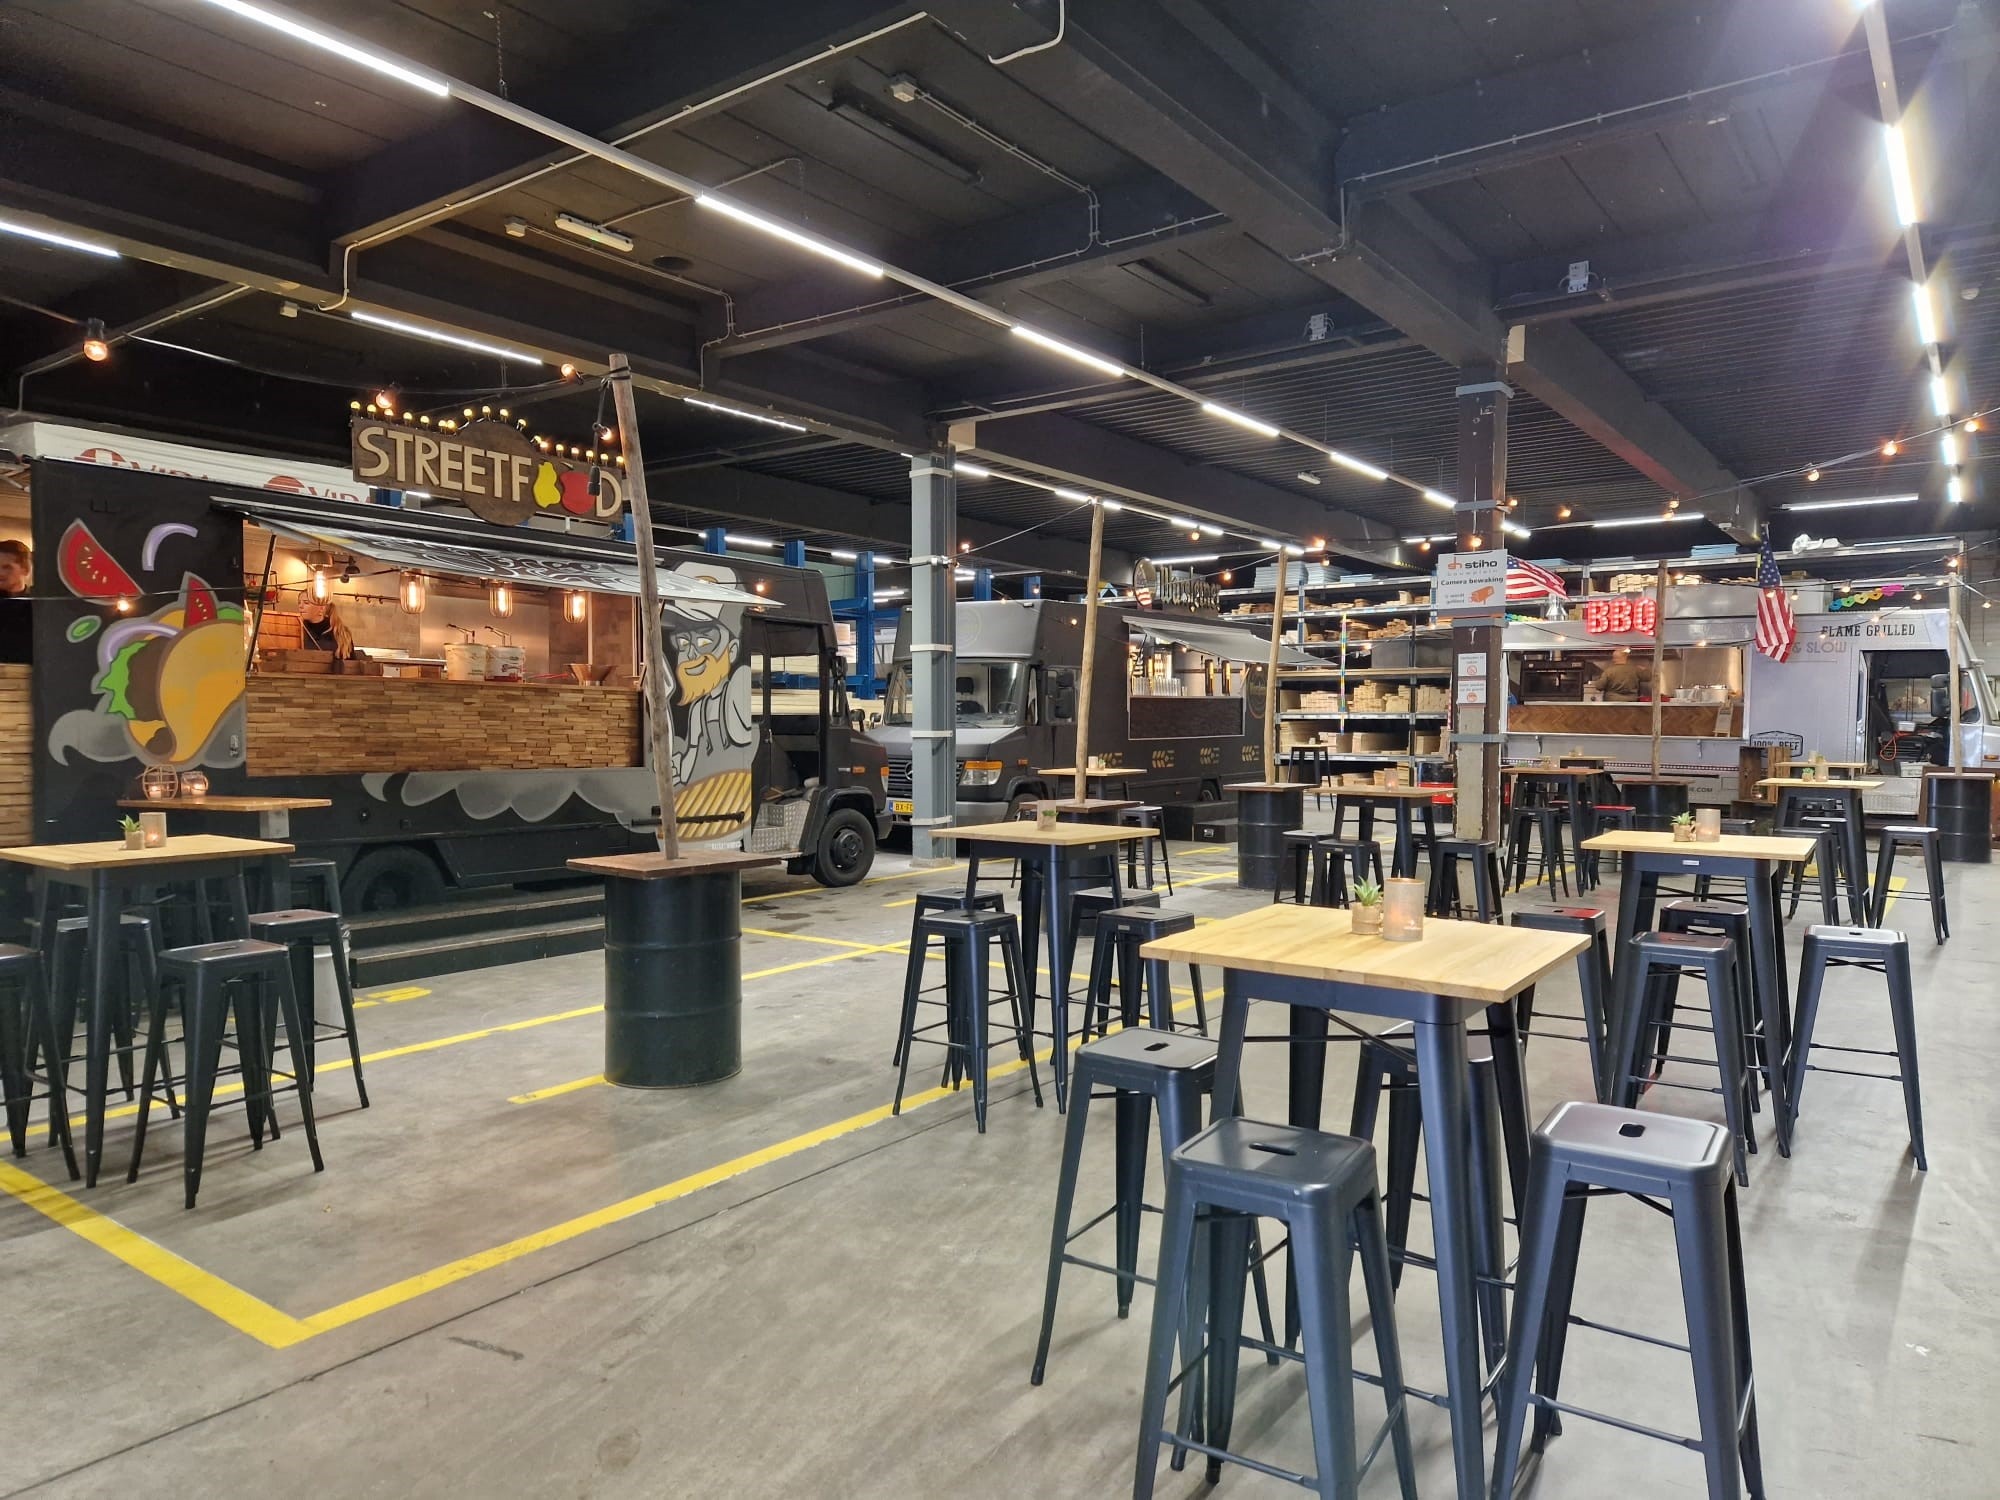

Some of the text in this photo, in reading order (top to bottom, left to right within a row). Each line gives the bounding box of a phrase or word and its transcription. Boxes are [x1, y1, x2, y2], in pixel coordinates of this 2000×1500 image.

[1464, 559, 1498, 569] stiho
[1587, 598, 1657, 637] BBQ
[1821, 624, 1916, 637] FLAME GRILLED
[1806, 642, 1847, 653] SLOW
